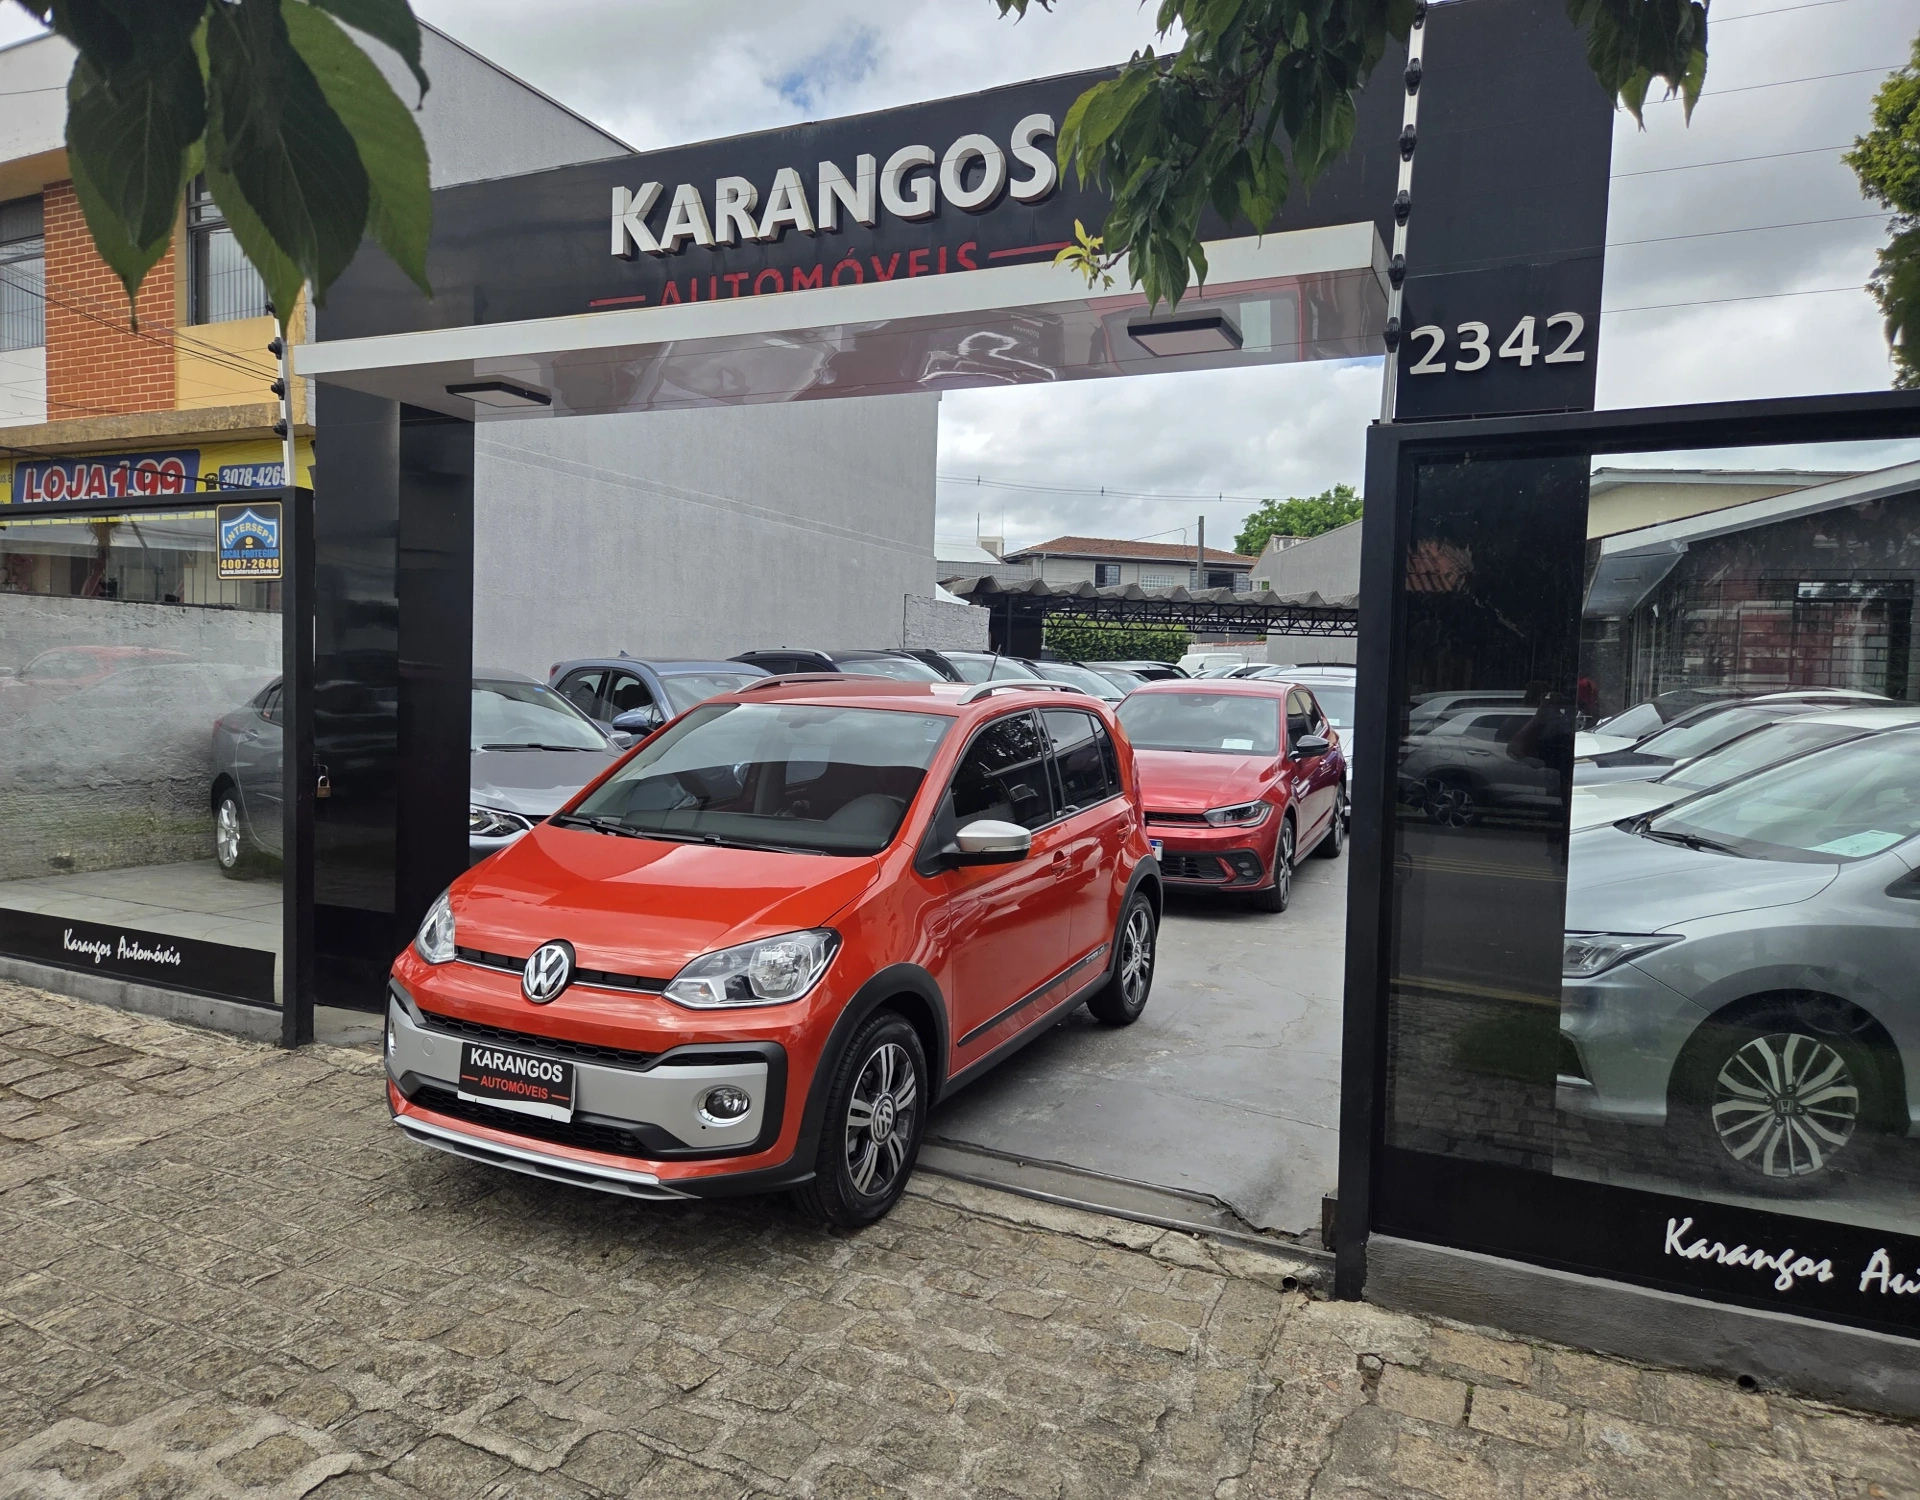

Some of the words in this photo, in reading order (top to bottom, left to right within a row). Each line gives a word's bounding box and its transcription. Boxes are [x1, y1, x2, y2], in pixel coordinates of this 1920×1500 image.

[611, 113, 1057, 259] KARANGOS
[661, 241, 977, 306] AUTOMÓVEIS
[1410, 312, 1584, 374] 2342
[23, 464, 108, 502] LOJA
[226, 522, 274, 545] INTERSEPT
[221, 549, 240, 558] LOCAL
[241, 549, 279, 558] PROTEGIDO
[221, 558, 279, 569] 4007-2640
[64, 928, 111, 964] Karangos
[117, 935, 181, 965] Automóveis
[523, 945, 569, 1003] VW
[470, 1047, 563, 1083] KARANGOS
[480, 1075, 548, 1099] AUTOMÓVEIS
[1665, 1217, 1834, 1291] Karangos
[1859, 1247, 1920, 1295] Au
